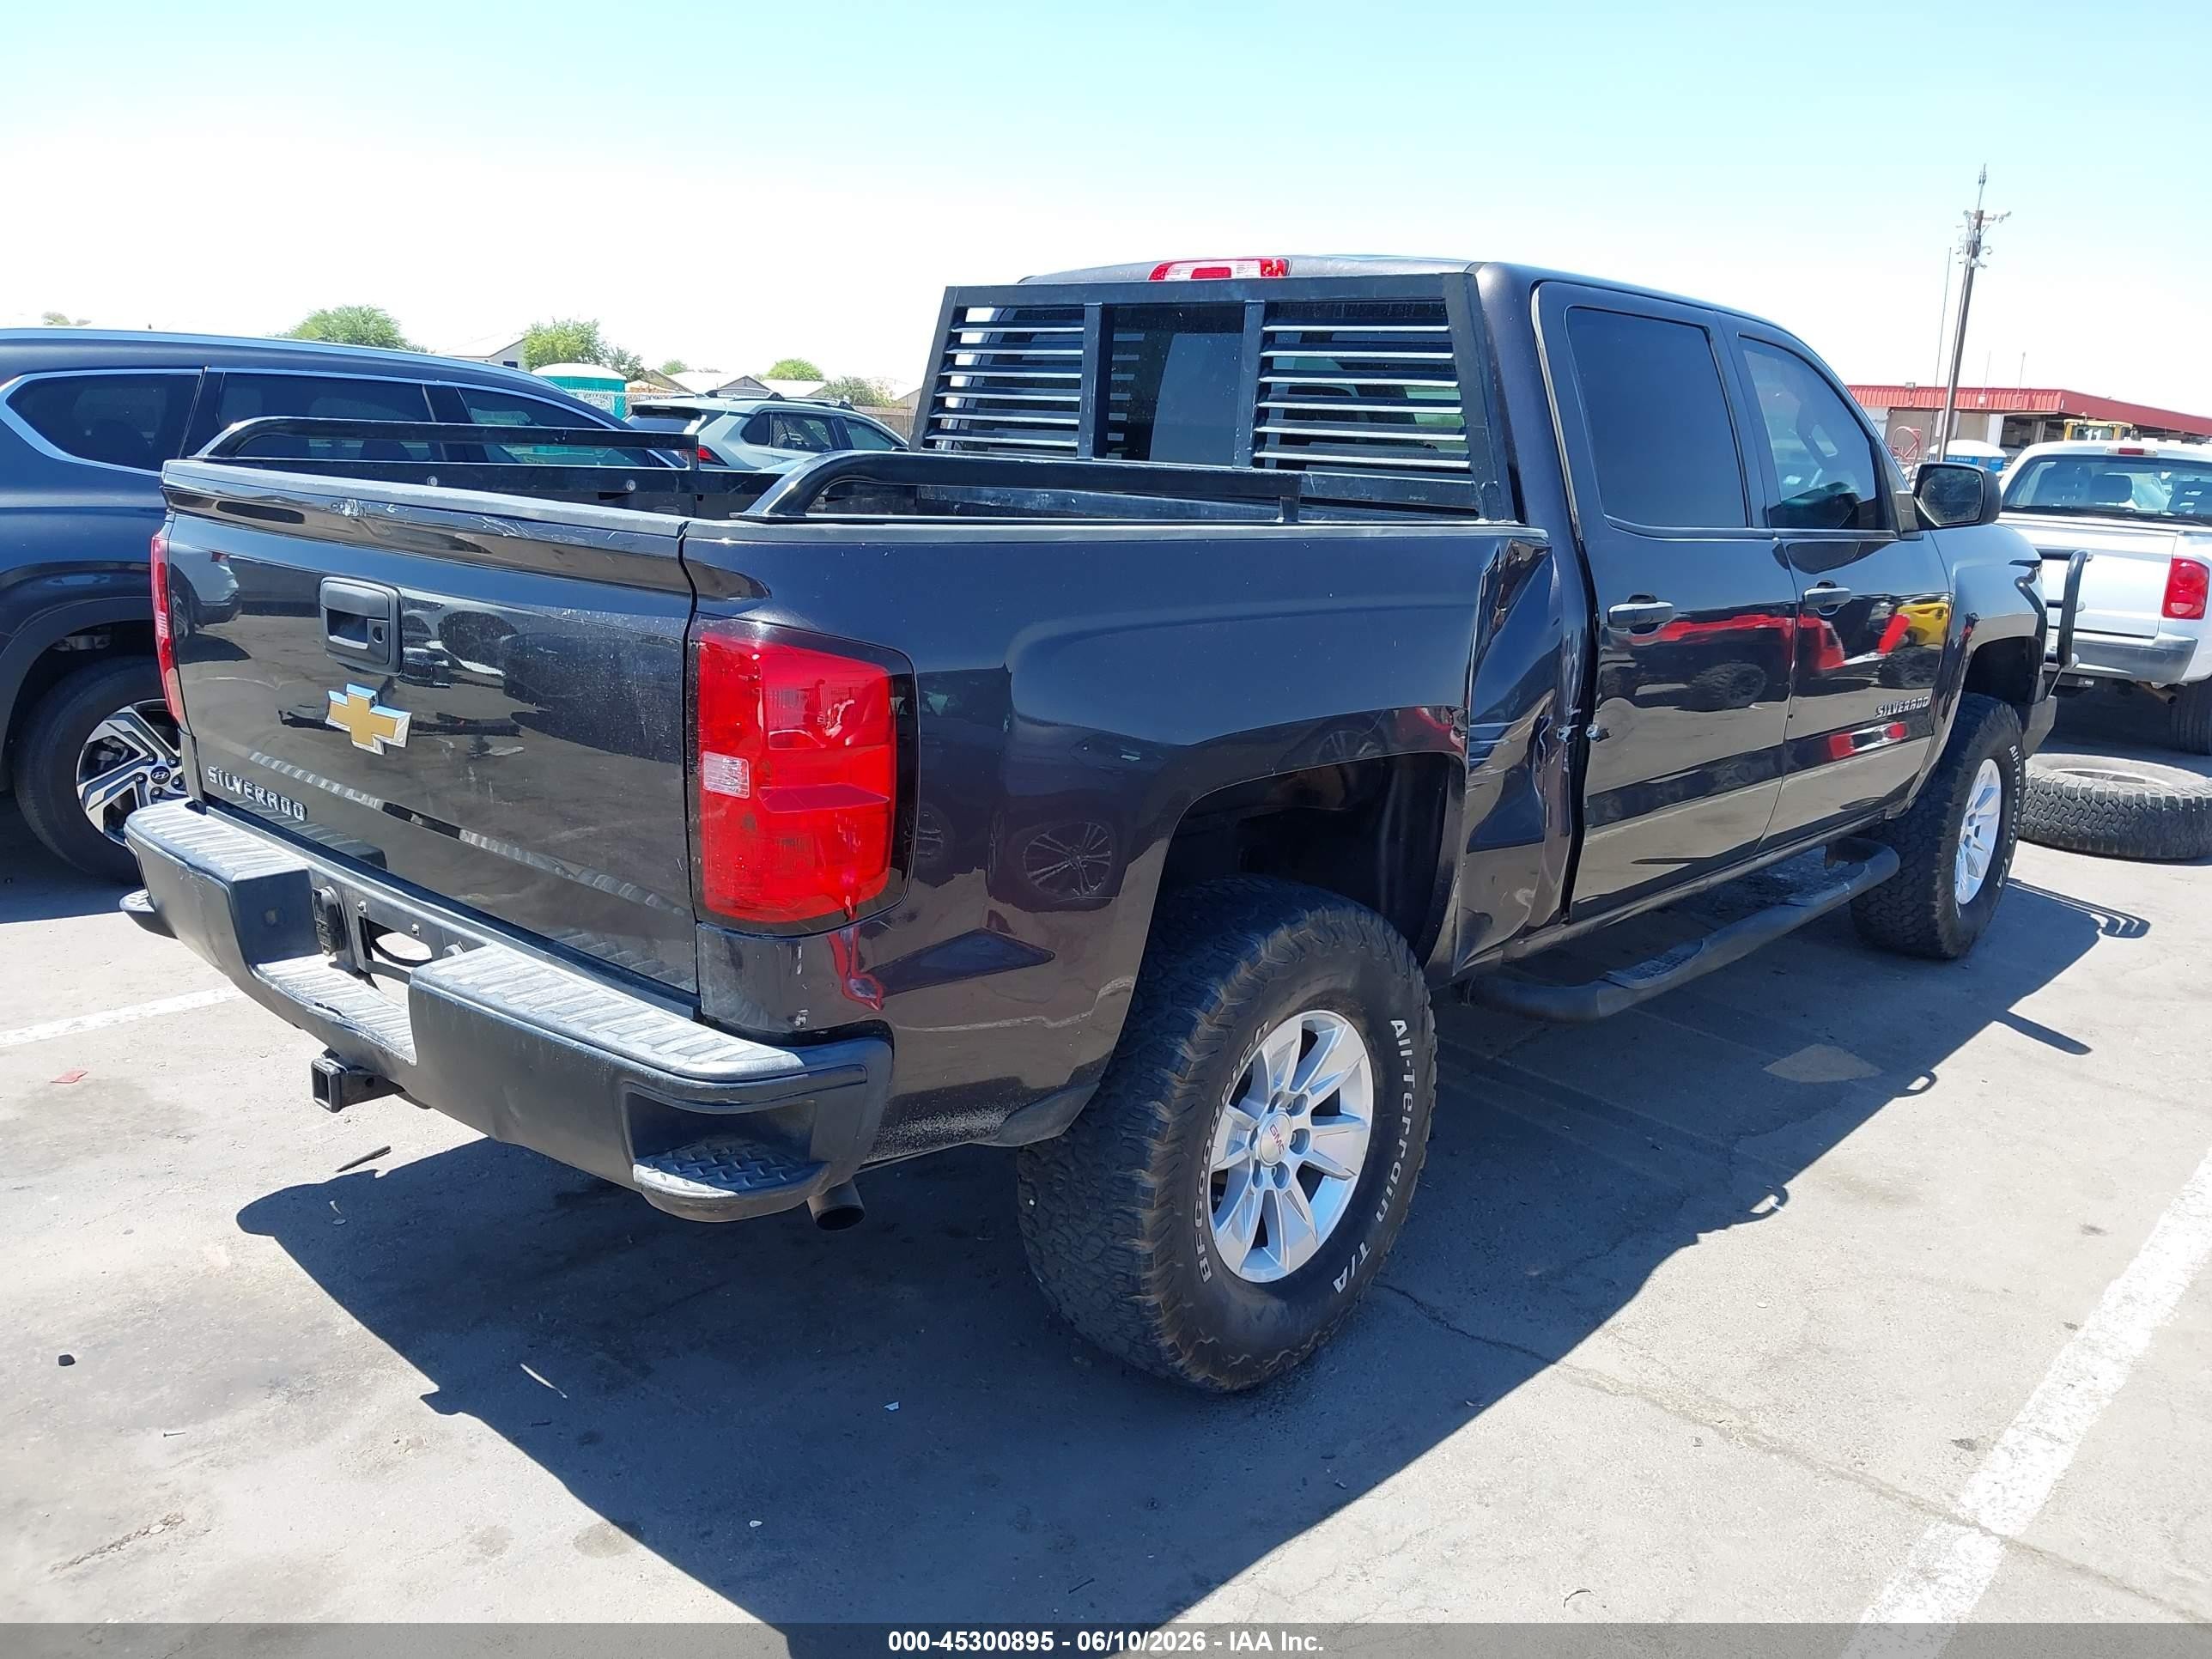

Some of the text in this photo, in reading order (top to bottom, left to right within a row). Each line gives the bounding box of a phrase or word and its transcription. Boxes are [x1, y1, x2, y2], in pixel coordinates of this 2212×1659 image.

[1875, 696, 1929, 718] SILVERADO
[207, 765, 307, 822] SILVERADO
[1269, 1123, 1285, 1155] GMC
[1333, 1018, 1416, 1293] All-Terrain T/A
